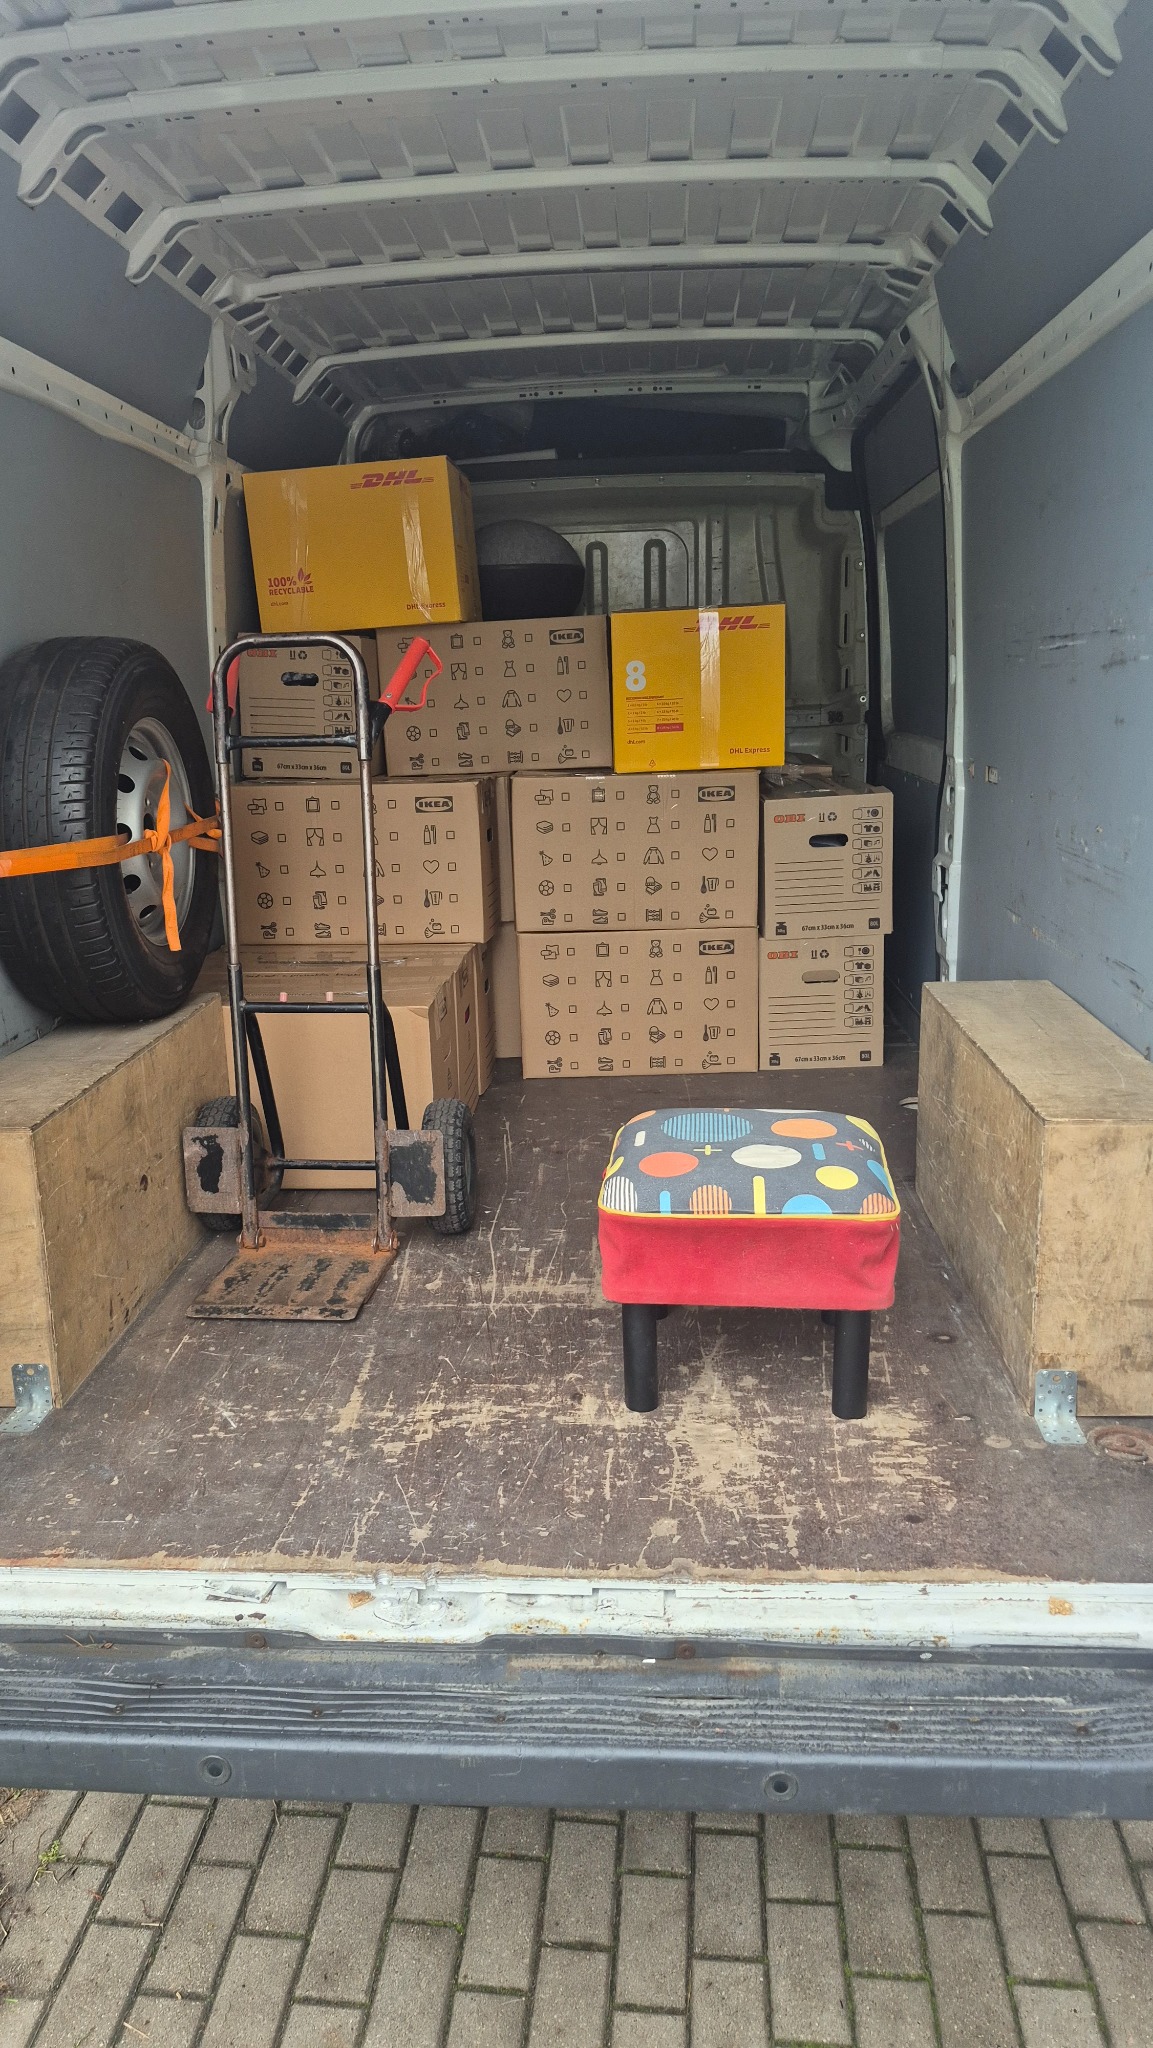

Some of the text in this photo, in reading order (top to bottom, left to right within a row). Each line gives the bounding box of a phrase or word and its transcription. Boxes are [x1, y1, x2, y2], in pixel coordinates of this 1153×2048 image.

[360, 469, 425, 489] DHL
[268, 576, 297, 588] 100%
[269, 585, 315, 596] RECYCLABLE
[552, 631, 582, 641] IKEA
[625, 660, 647, 692] 8
[745, 747, 771, 755] Express
[701, 789, 732, 798] IKEA
[418, 799, 450, 809] IKEA
[773, 814, 806, 824] OBI
[702, 943, 732, 952] IKEA
[767, 950, 799, 960] OBI
